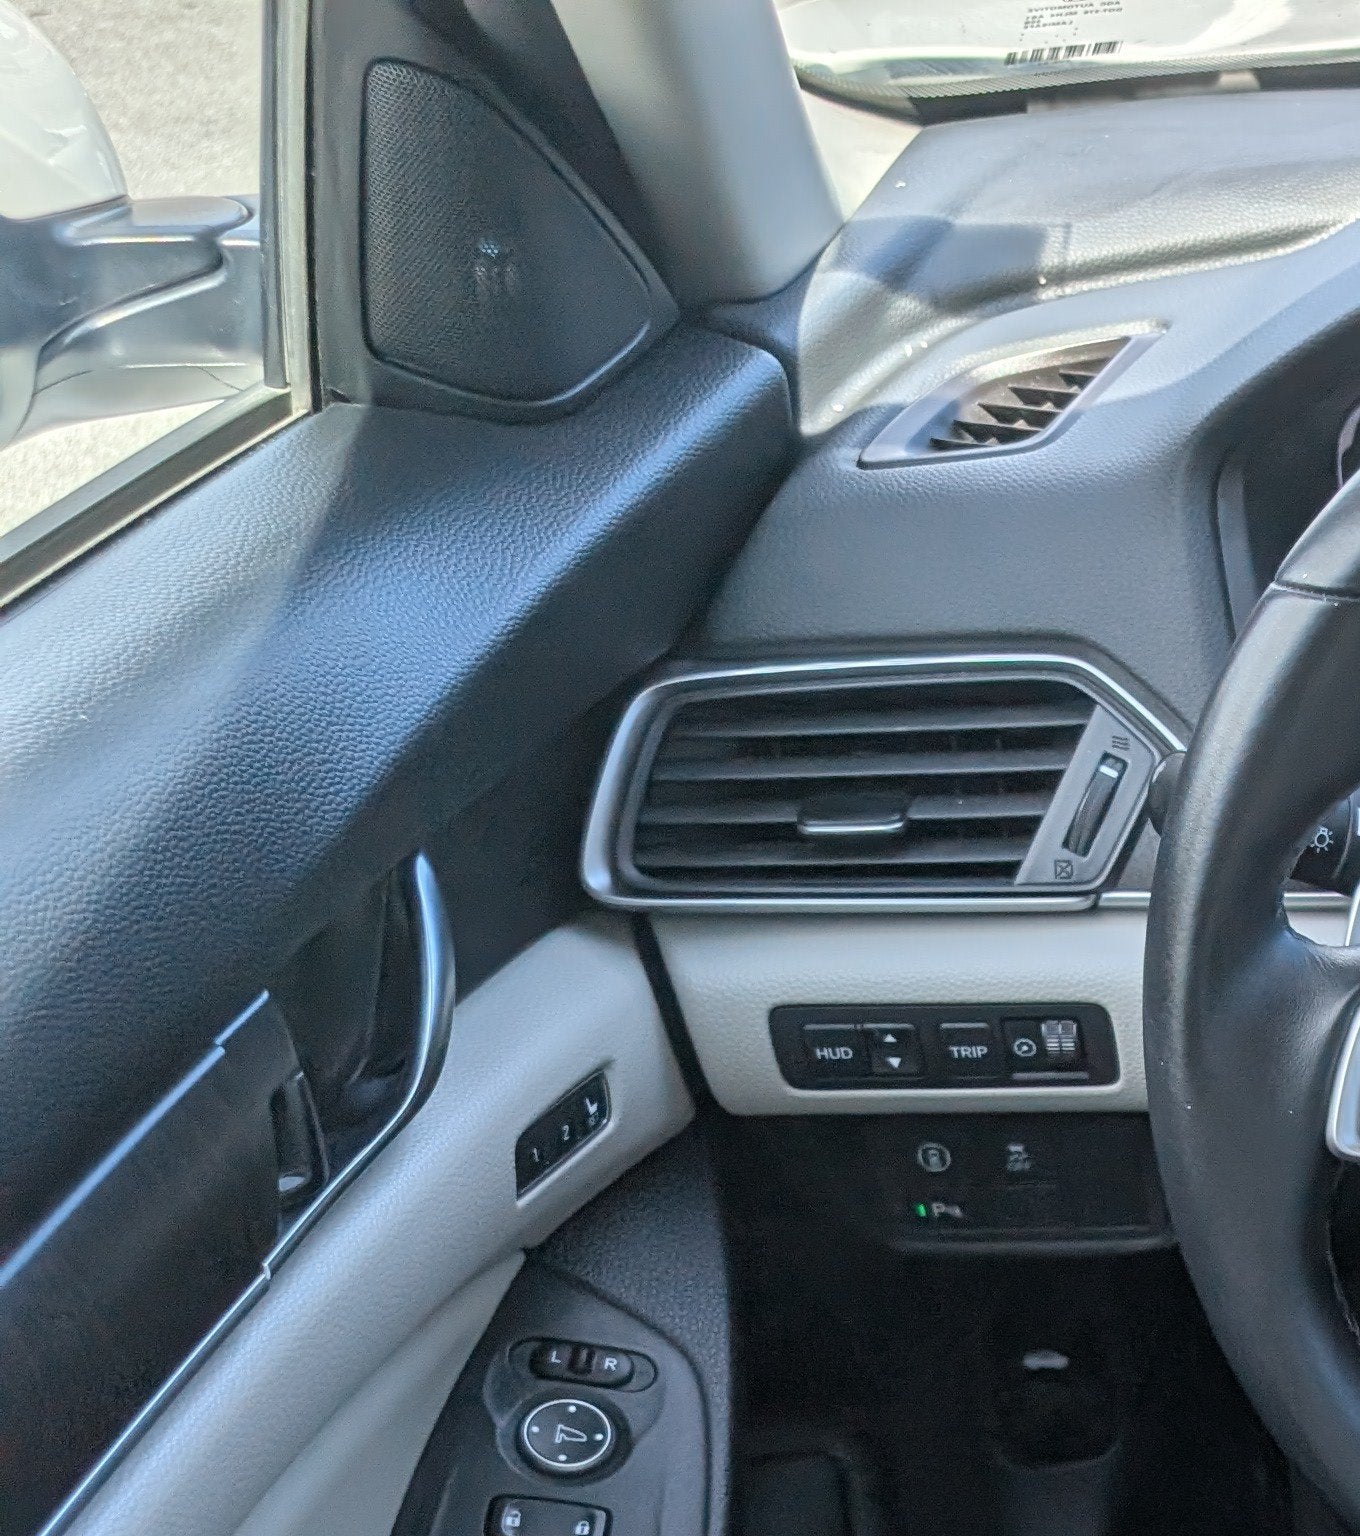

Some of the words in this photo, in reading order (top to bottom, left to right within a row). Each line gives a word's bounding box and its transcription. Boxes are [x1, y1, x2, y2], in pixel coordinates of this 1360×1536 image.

[815, 1046, 854, 1060] HUD
[949, 1045, 988, 1059] TRIP
[562, 1124, 570, 1141] 2
[532, 1147, 540, 1163] 1
[550, 1350, 562, 1364] L
[603, 1357, 618, 1372] R
